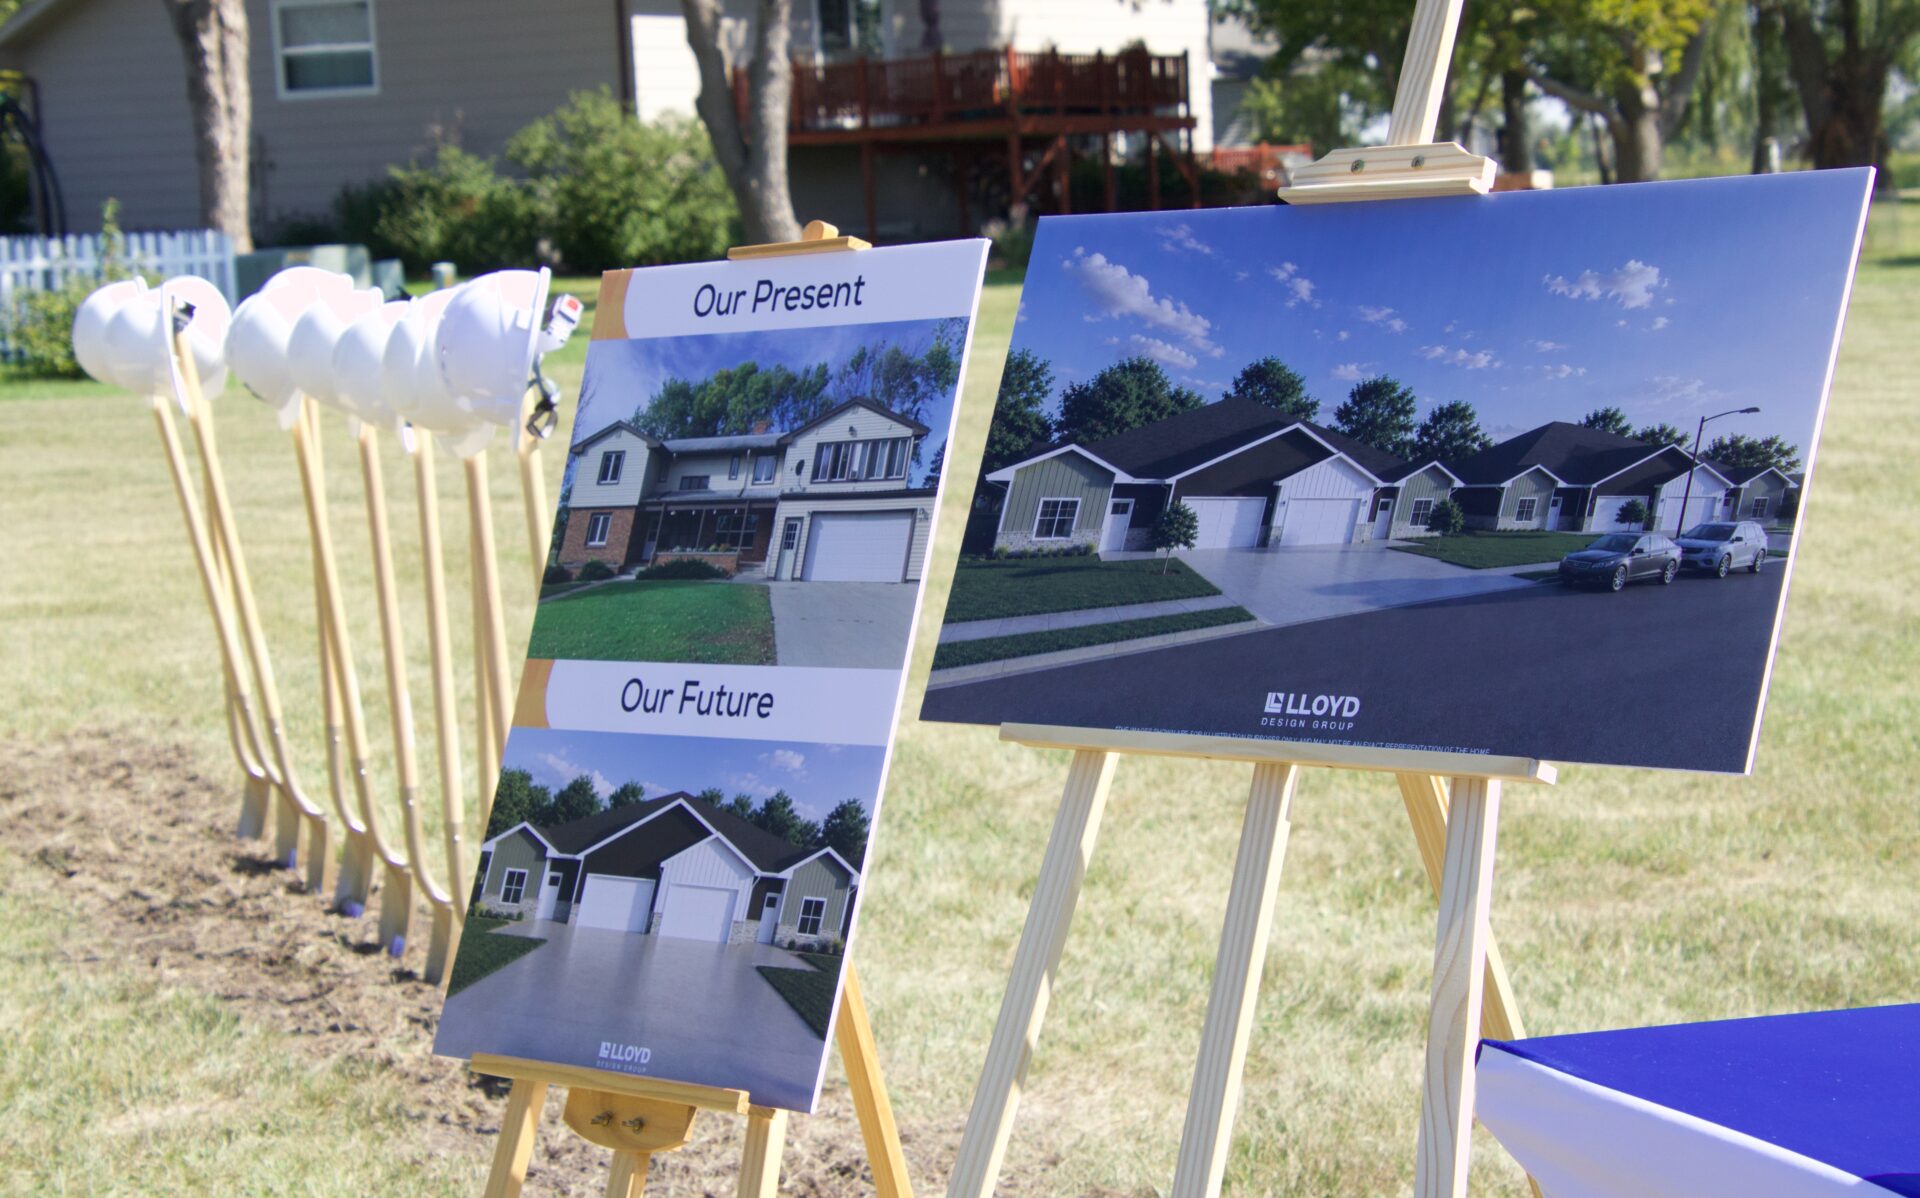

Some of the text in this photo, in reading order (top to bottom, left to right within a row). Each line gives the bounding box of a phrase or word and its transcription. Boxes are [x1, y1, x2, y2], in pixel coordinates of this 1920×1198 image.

[693, 275, 865, 317] Our Present
[621, 678, 774, 718] Our Future
[1285, 693, 1361, 718] LLOYD
[1261, 717, 1354, 731] DESIGN GROUP
[610, 1043, 652, 1064] LLOYD
